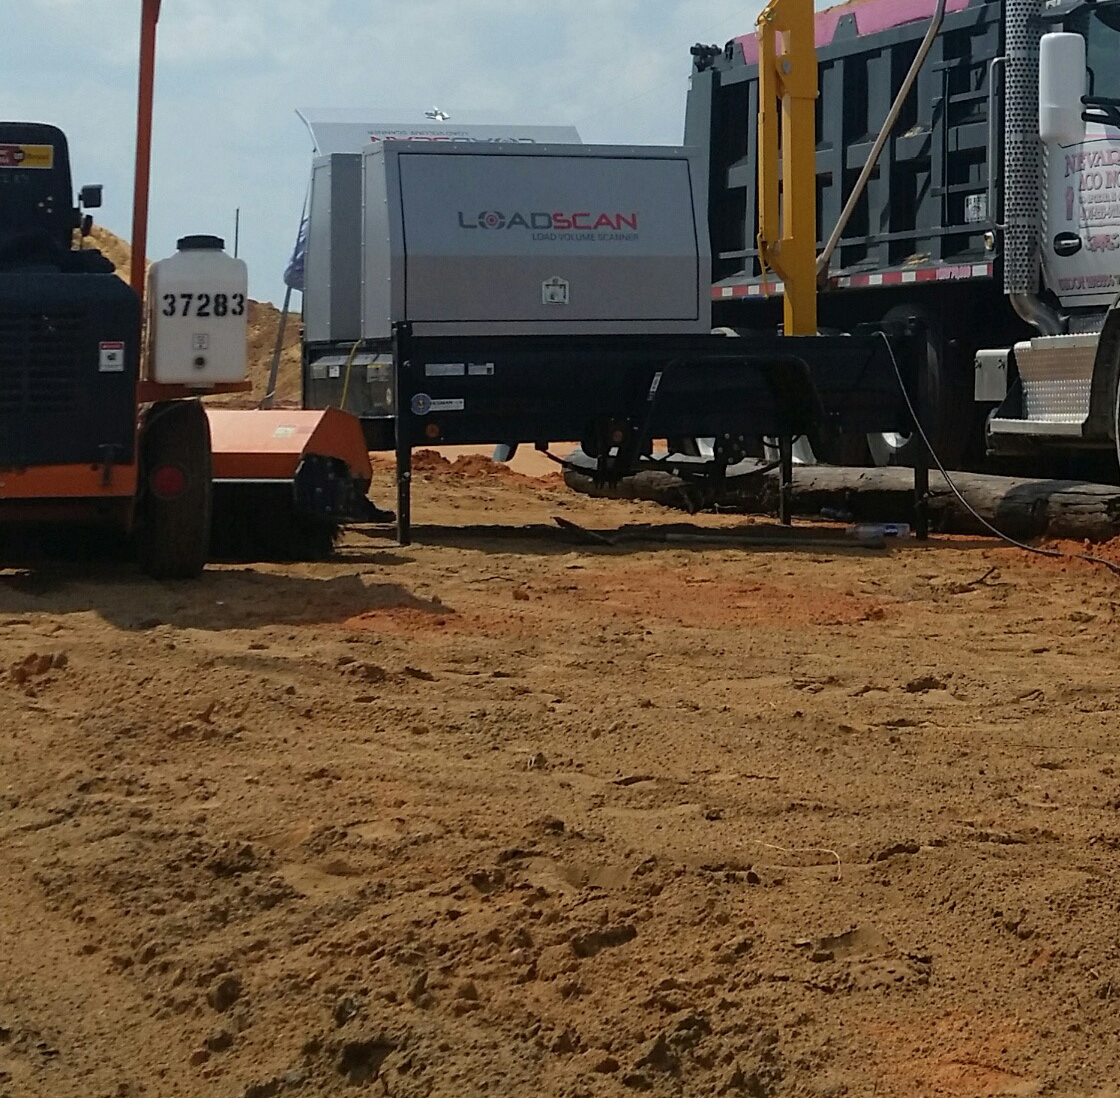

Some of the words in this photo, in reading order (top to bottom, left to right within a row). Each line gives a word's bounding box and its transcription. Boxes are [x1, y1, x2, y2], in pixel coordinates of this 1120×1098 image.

[457, 211, 638, 230] LOADSCAN
[532, 233, 556, 241] LOAD
[559, 233, 596, 241] VOLUME
[598, 233, 639, 241] SCANNER
[162, 293, 244, 317] 37283
